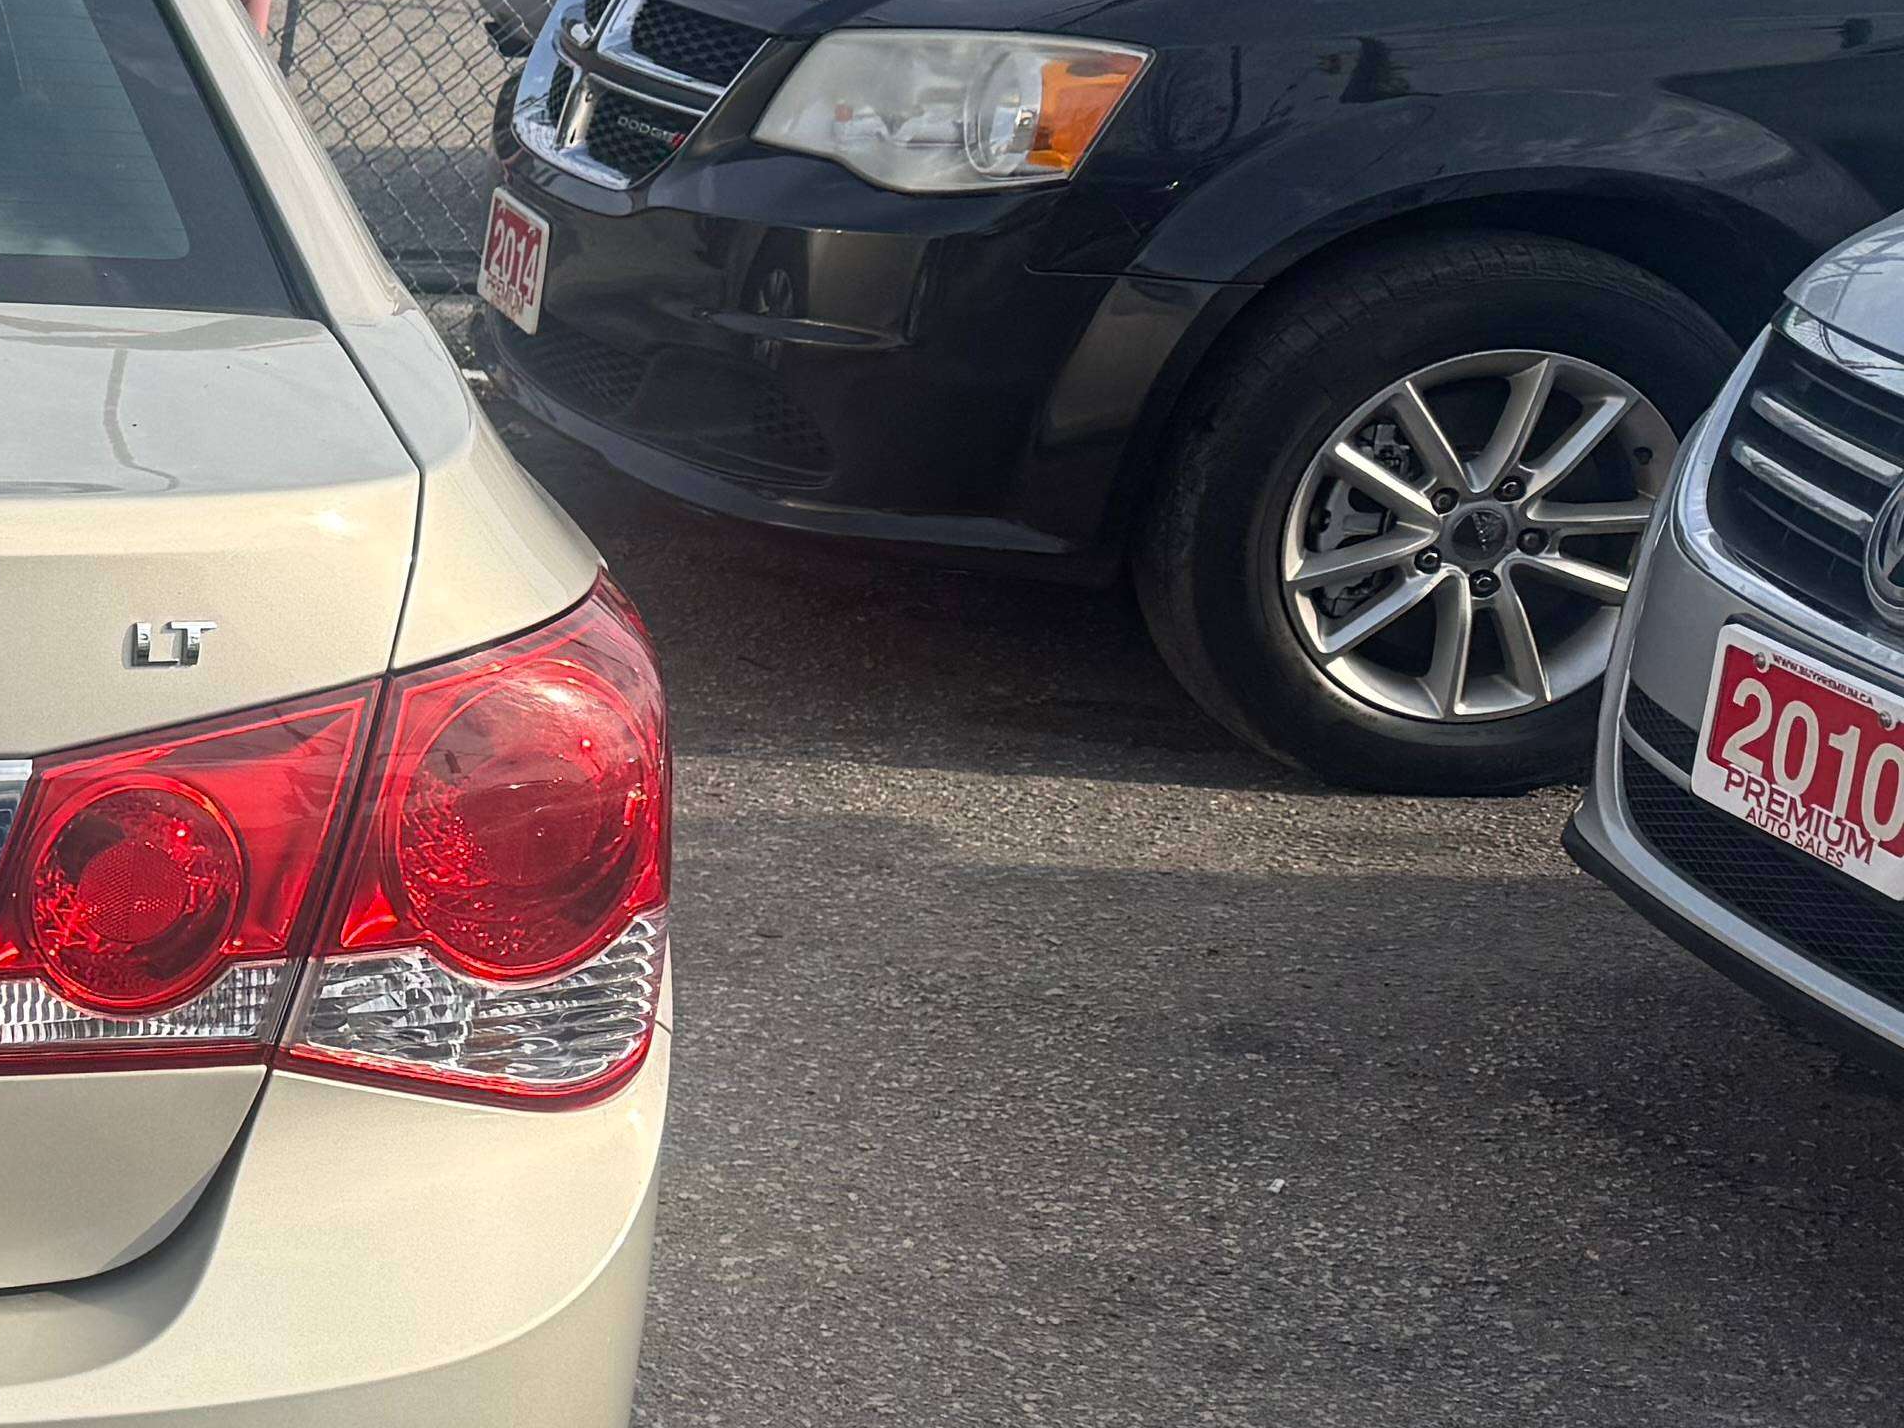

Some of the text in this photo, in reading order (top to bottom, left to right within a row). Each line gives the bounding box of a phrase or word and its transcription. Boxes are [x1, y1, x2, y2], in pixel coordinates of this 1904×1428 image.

[490, 219, 539, 301] 2014
[128, 621, 218, 667] LT
[1721, 678, 1904, 842] 2010
[1724, 767, 1878, 865] PREMIUM
[1745, 807, 1847, 869] AUTO SALES
